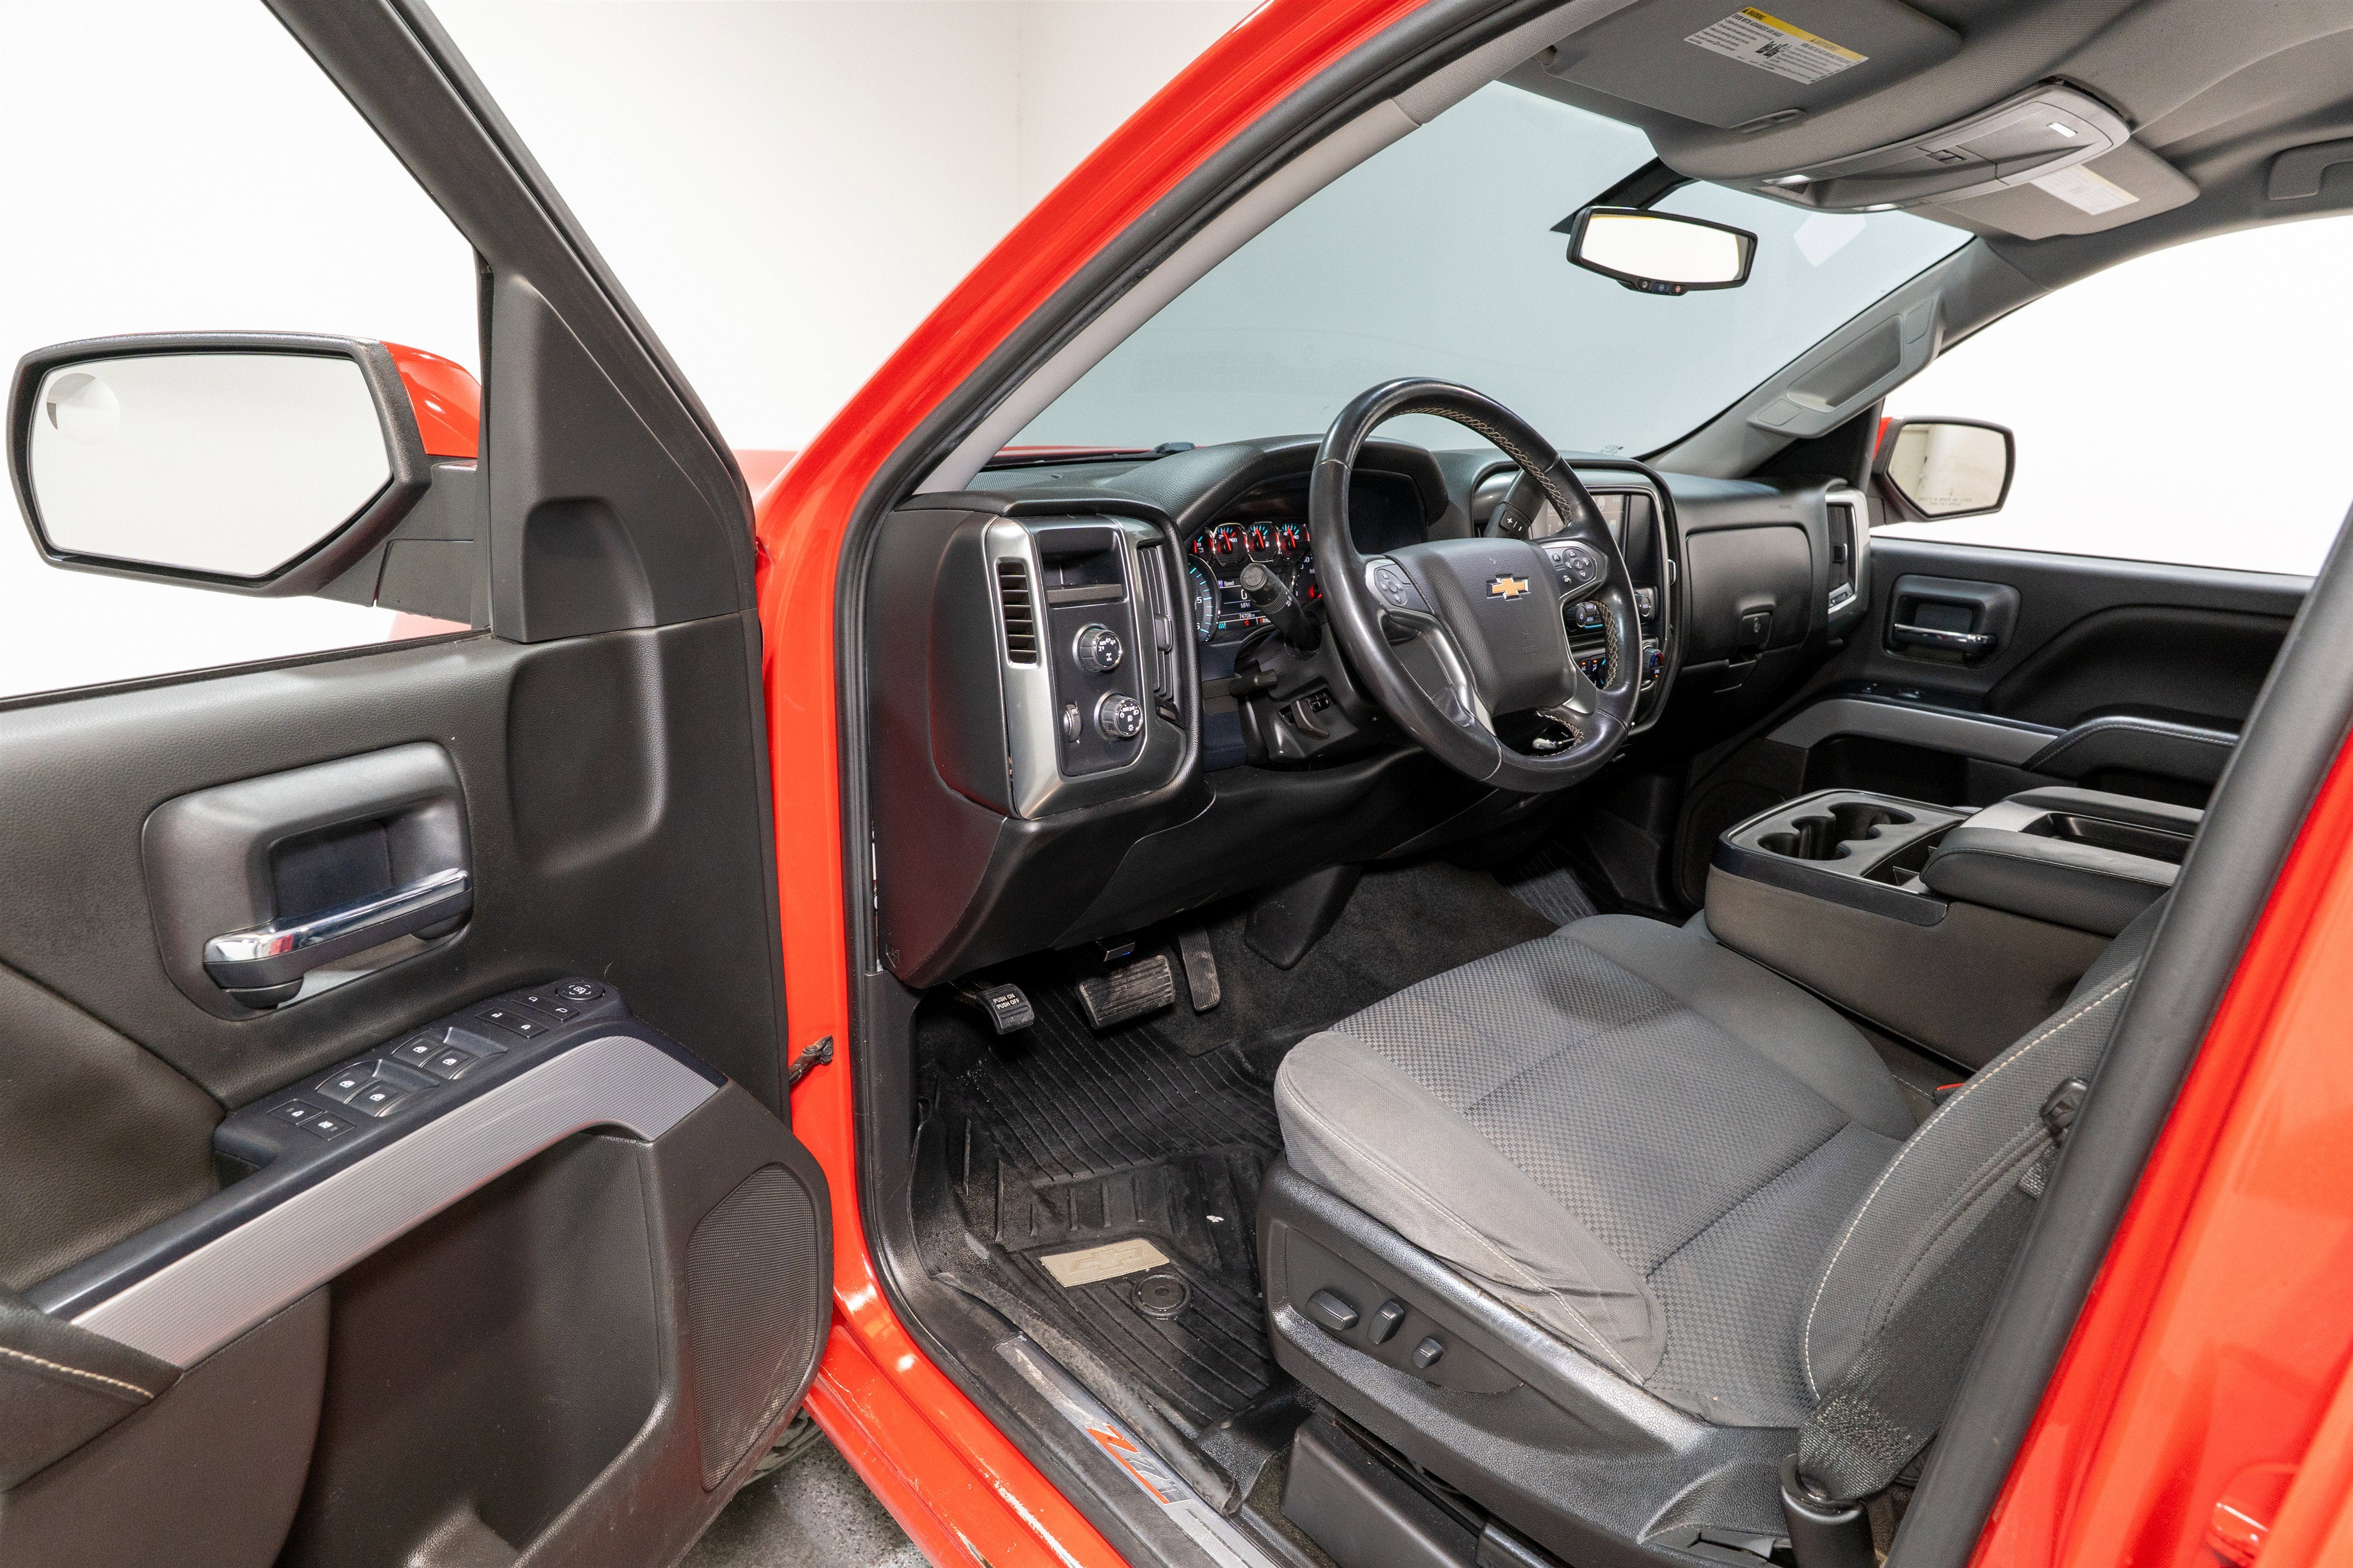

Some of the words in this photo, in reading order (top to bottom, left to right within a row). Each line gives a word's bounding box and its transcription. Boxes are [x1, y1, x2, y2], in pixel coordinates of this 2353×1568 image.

[1241, 589, 1248, 600] 0
[993, 995, 1008, 1004] PUSH
[996, 1001, 1011, 1010] PUSH
[1085, 1422, 1193, 1505] Z71
